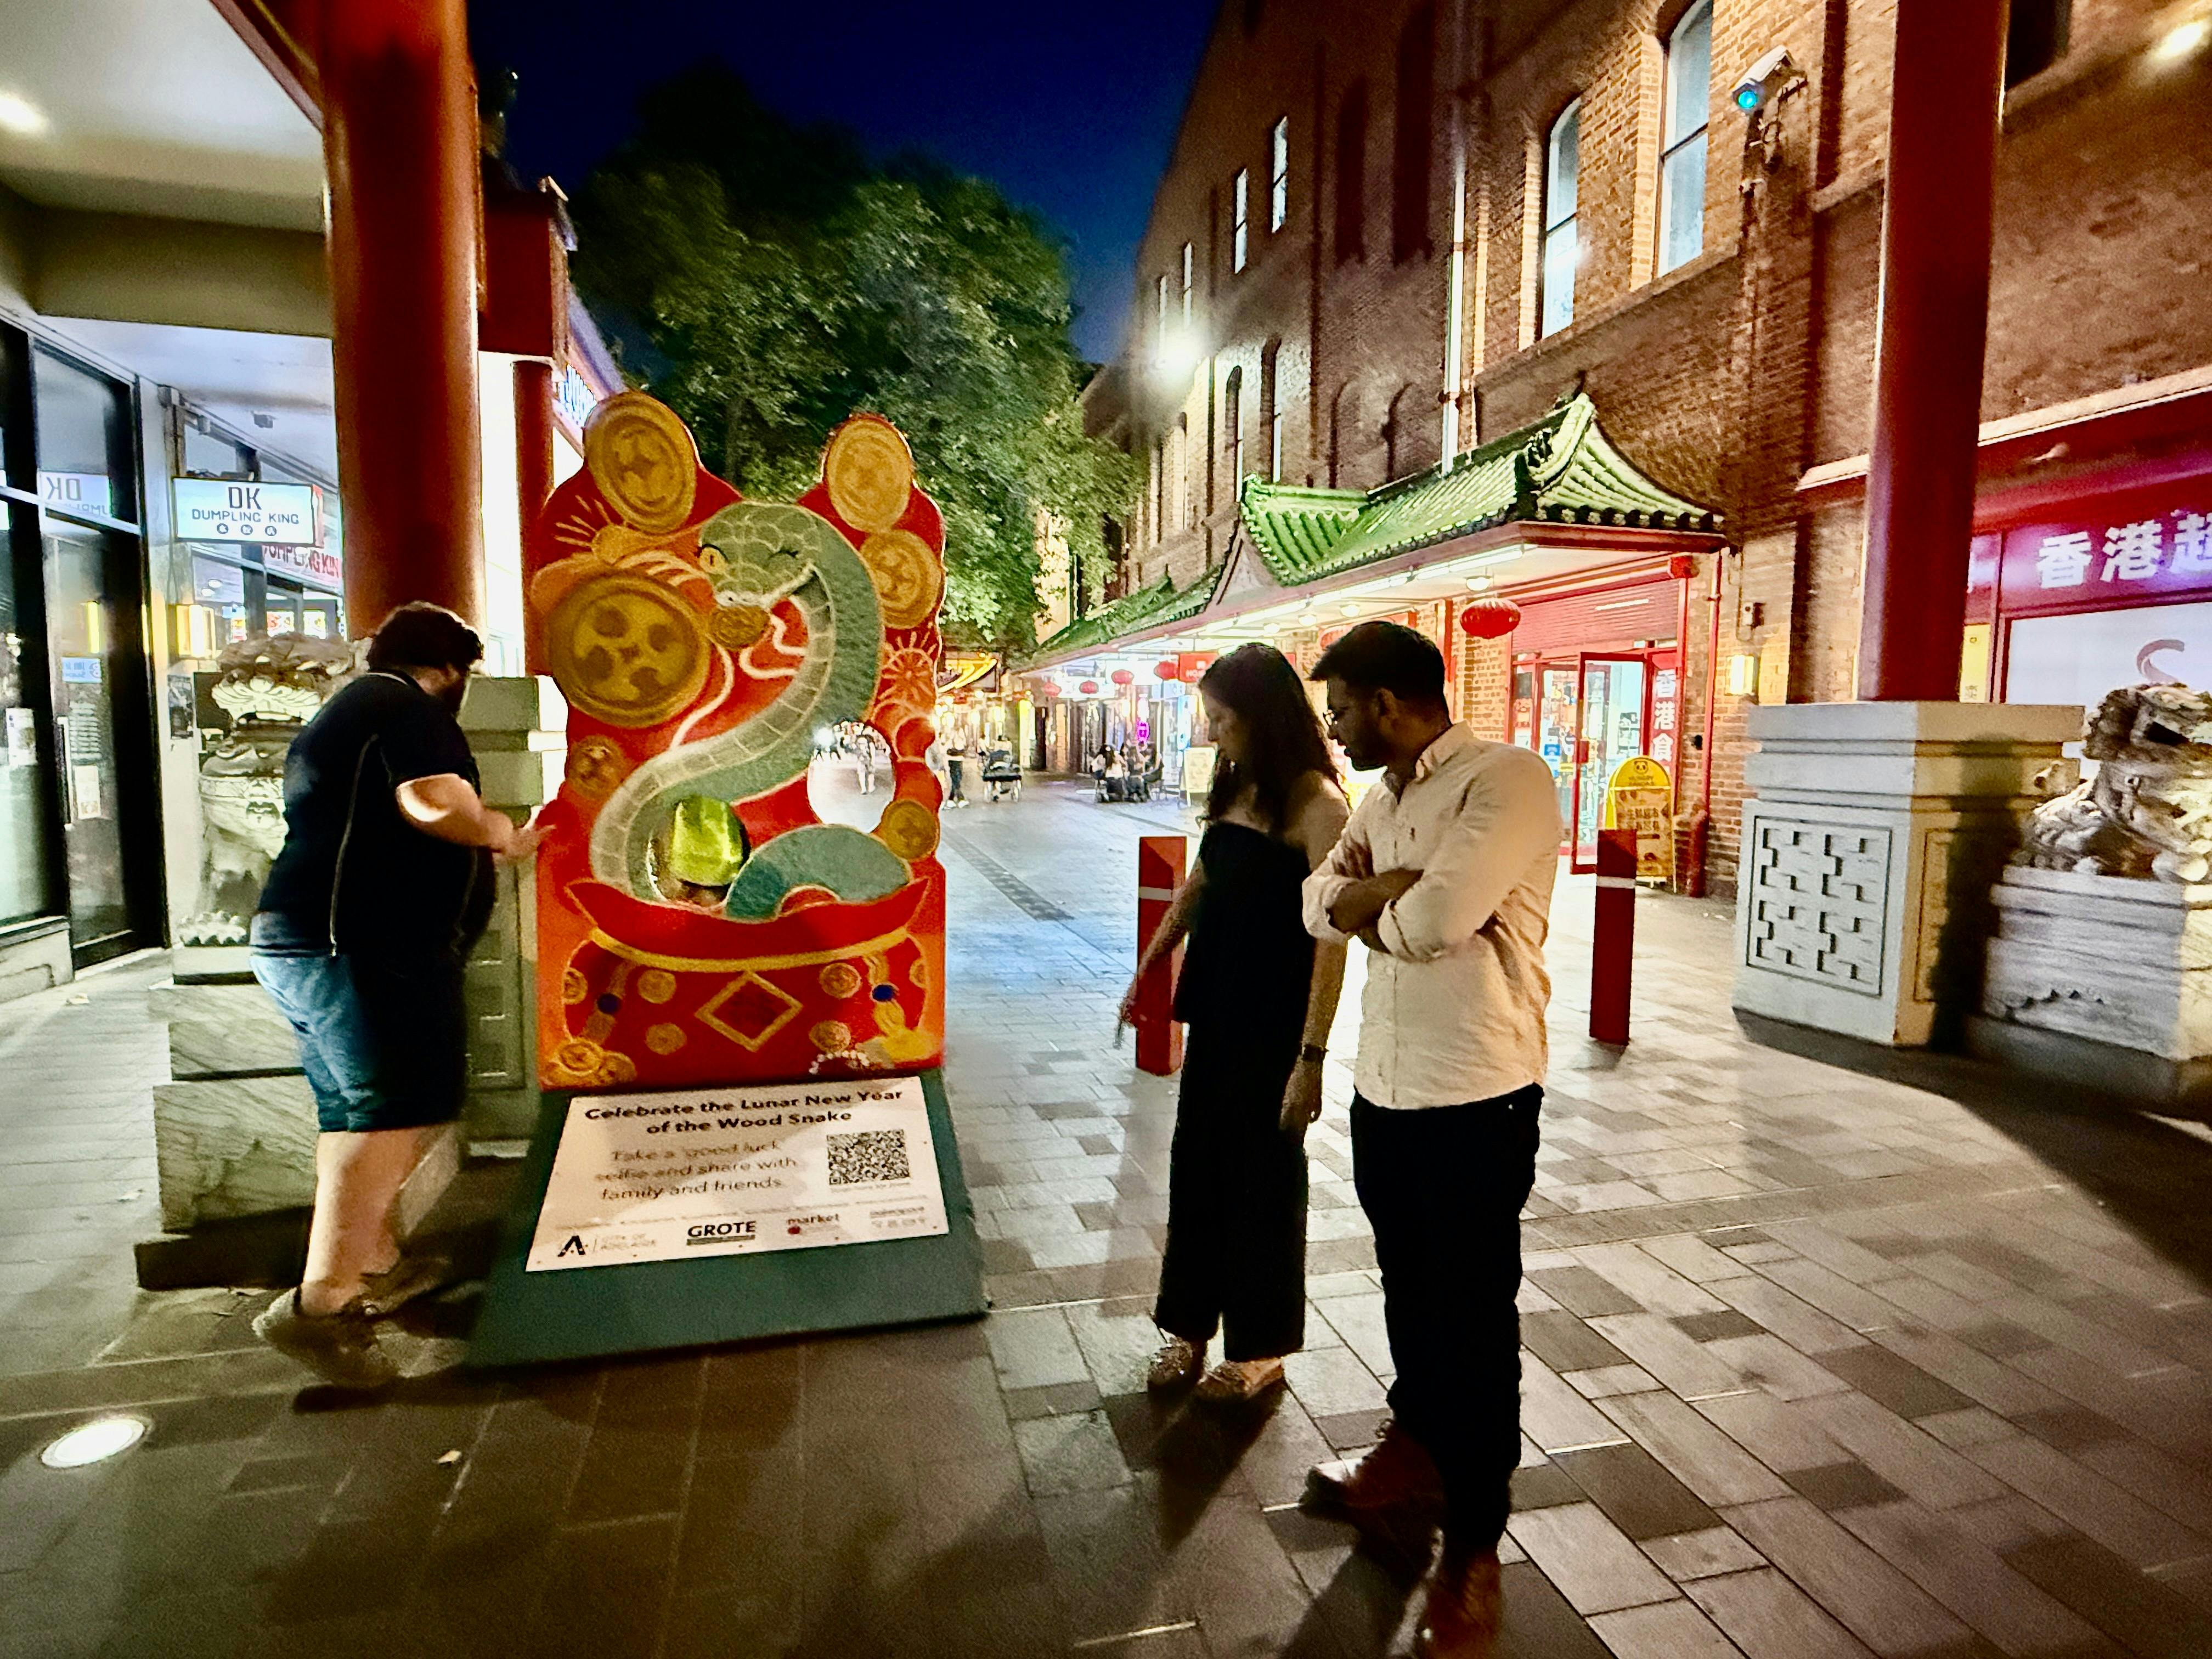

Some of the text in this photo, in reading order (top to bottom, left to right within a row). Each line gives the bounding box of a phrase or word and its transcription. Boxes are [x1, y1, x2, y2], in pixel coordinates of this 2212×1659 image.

[228, 487, 262, 510] DK
[192, 509, 299, 524] DUMPLING KING
[585, 1091, 902, 1120] Celebrate the Lunar New Year
[647, 1111, 851, 1133] of the Wood Snake
[757, 1157, 796, 1169] with
[602, 1176, 781, 1200] family and friends
[687, 1221, 757, 1237] GROTE
[786, 1214, 839, 1225] market
